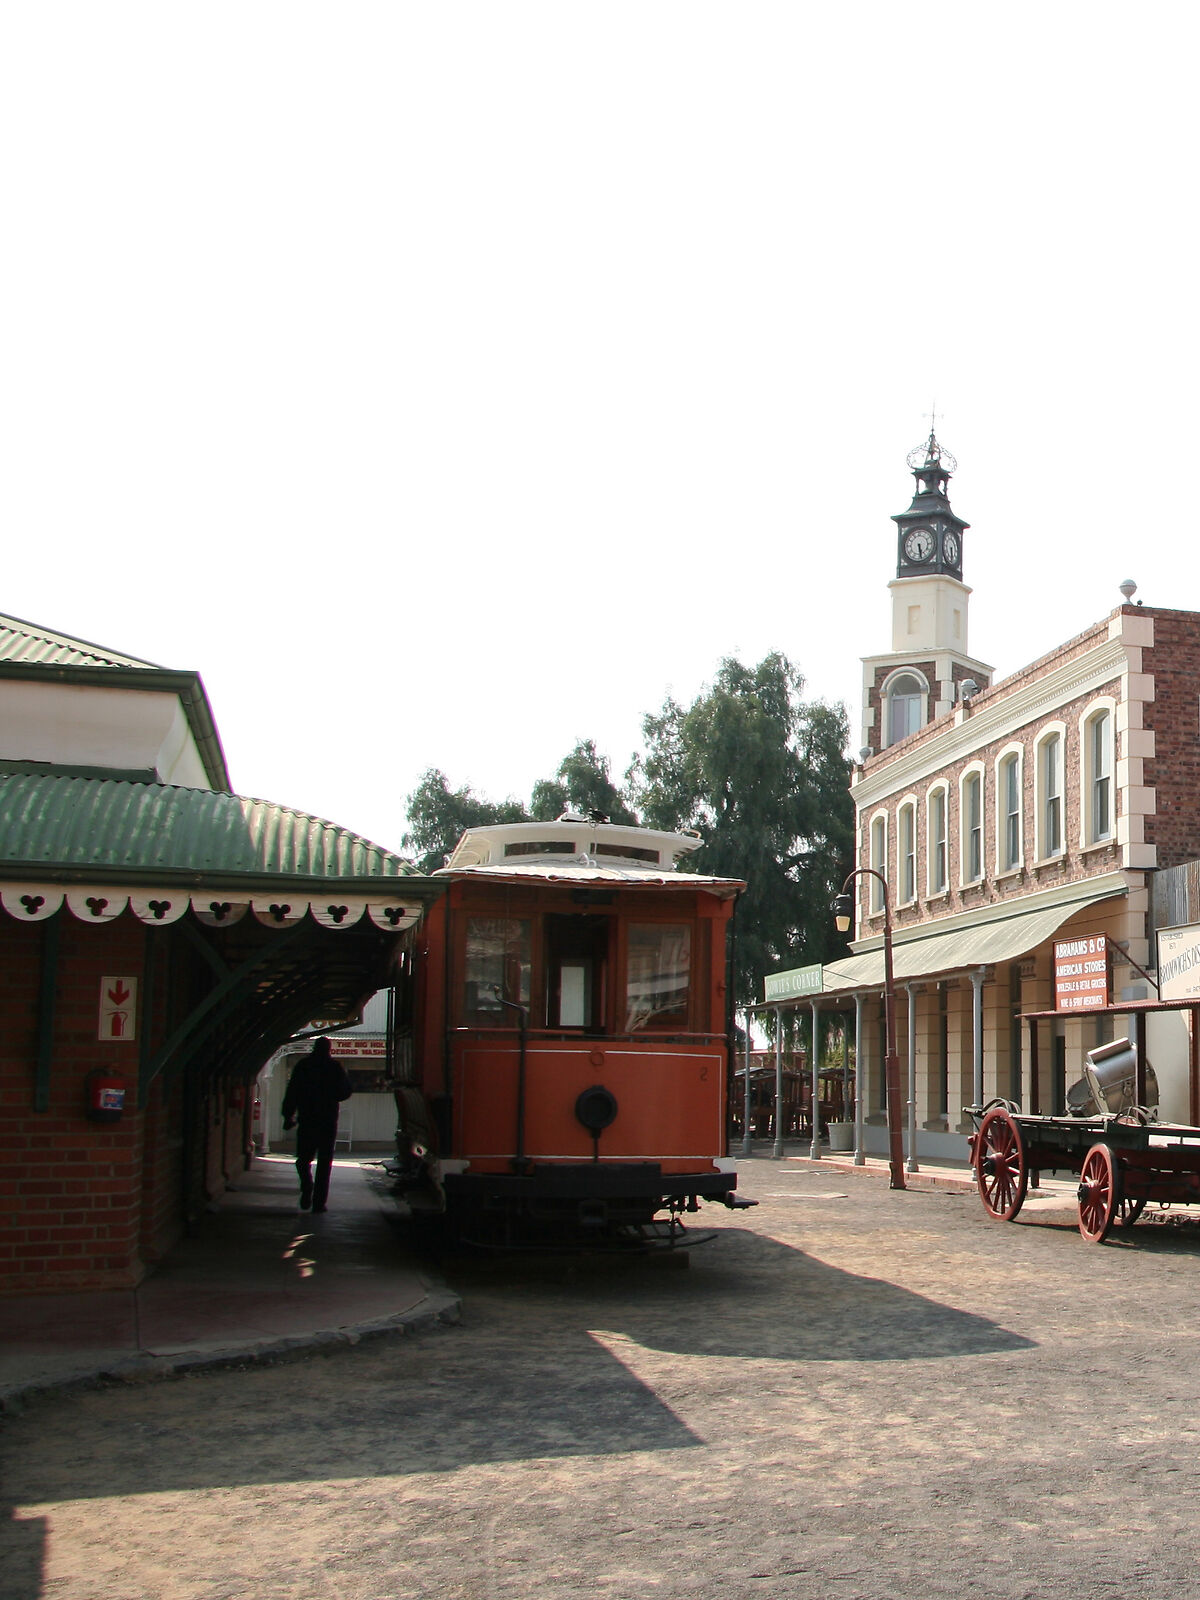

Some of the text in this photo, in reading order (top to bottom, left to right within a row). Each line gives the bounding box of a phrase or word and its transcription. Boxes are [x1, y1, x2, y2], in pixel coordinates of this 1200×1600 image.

[1056, 940, 1088, 959] ABRAHAMS
[1089, 939, 1095, 953] &
[1056, 960, 1106, 977] AMERICAN STORES
[792, 971, 820, 991] CORNER
[370, 1041, 385, 1049] HOL
